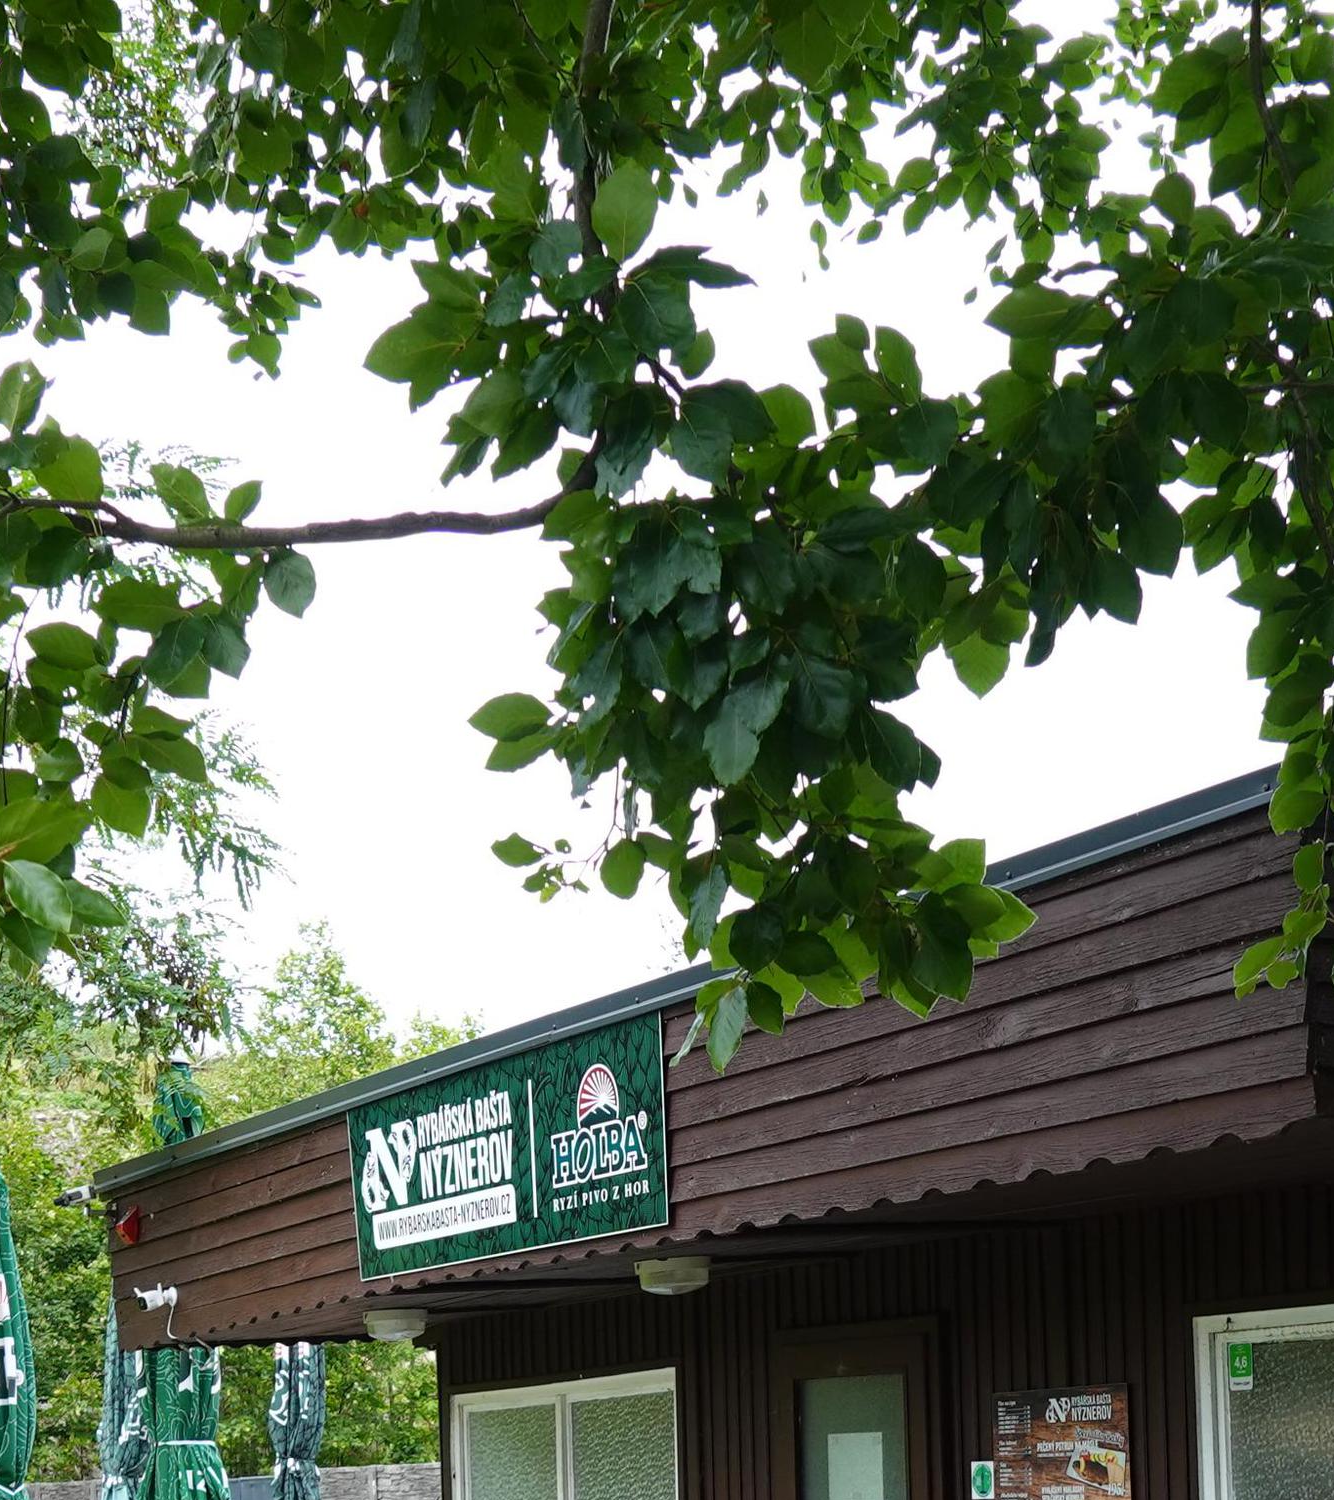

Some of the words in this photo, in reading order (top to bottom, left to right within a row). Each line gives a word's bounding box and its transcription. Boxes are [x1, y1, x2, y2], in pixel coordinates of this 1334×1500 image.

[416, 1097, 474, 1149] RYBÁŘSKÁ
[475, 1090, 512, 1133] BAŠTA
[419, 1129, 513, 1200] NÝZNEROV
[551, 1114, 648, 1189] HOLBA
[378, 1193, 511, 1241] WWW.RYBARSKABASTA-NYZNEROV.CZ
[553, 1190, 578, 1212] RYZÍ
[582, 1188, 608, 1206] PIVO
[612, 1185, 620, 1200] Z
[624, 1180, 650, 1198] HOR
[1071, 1405, 1112, 1421] NÝZNEROV
